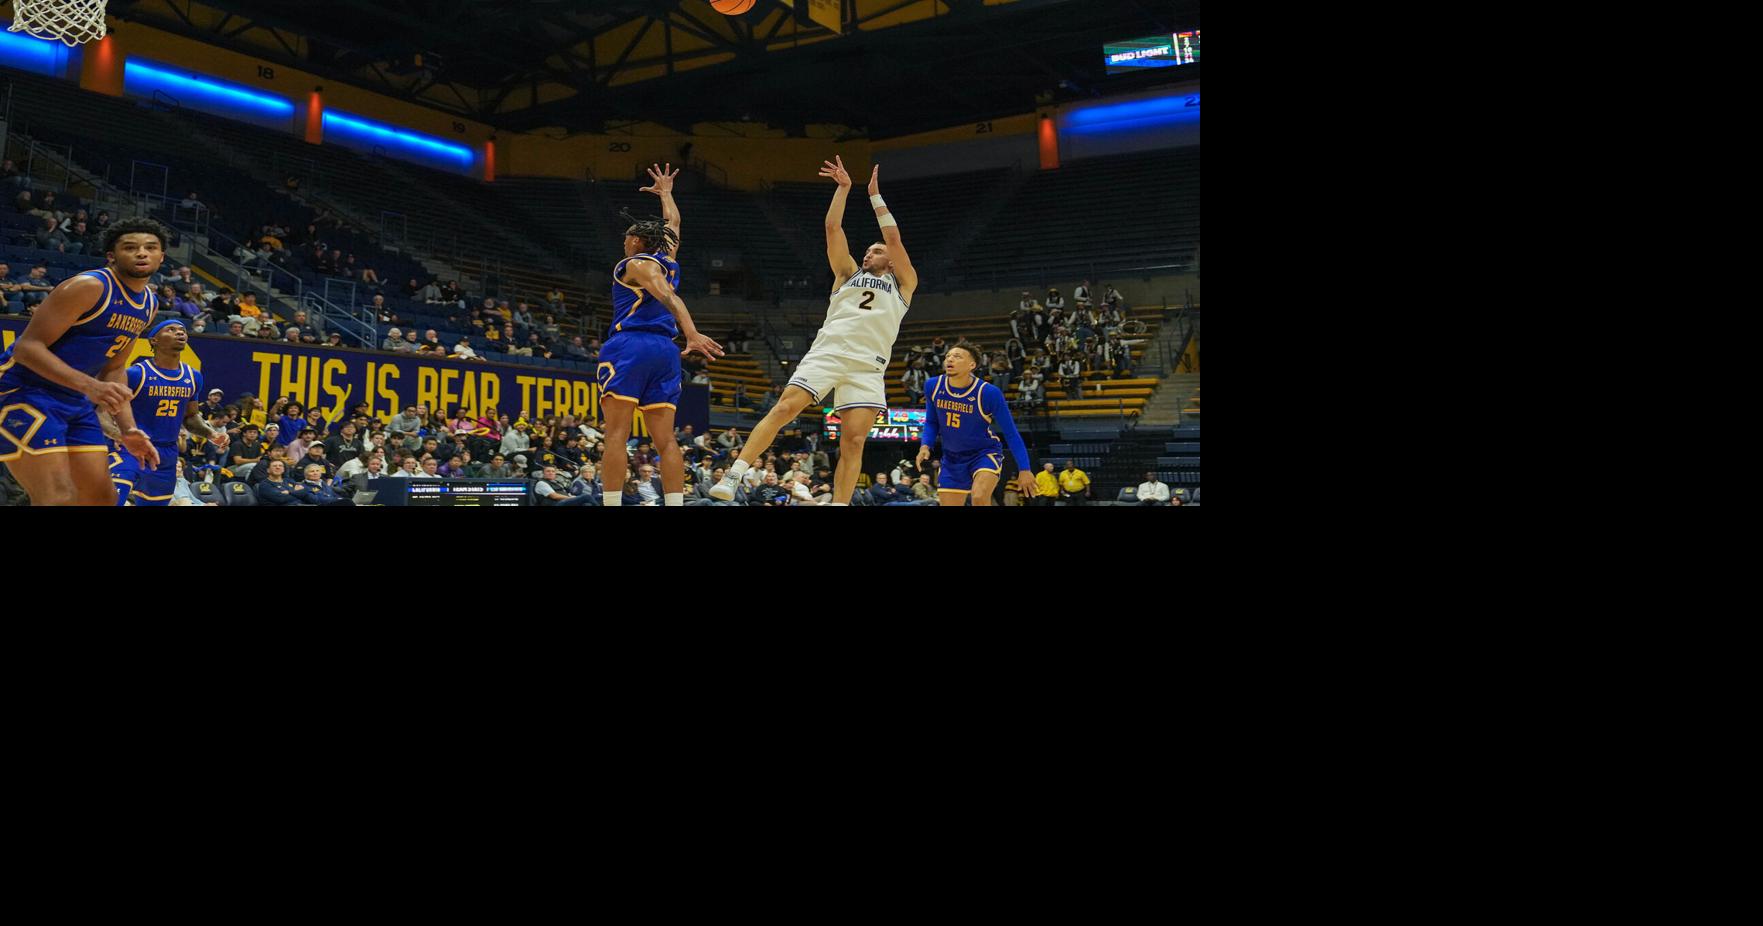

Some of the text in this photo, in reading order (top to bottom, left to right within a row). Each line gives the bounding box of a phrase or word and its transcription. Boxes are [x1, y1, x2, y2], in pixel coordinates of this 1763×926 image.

[1111, 47, 1169, 62] BUD LIGHT
[257, 65, 274, 80] 18
[1184, 97, 1200, 108] 2
[452, 121, 465, 133] 19
[976, 123, 992, 134] 21
[609, 142, 631, 152] 20
[850, 277, 892, 295] ALIFORNIA
[858, 290, 875, 311] 2
[148, 385, 192, 399] BAKERSFIELD
[252, 351, 348, 424] THIS
[364, 361, 400, 425] IS
[417, 366, 500, 425] BEAR
[155, 399, 180, 417] 25
[936, 399, 974, 414] BAKERSFIELD
[946, 412, 961, 429] 15
